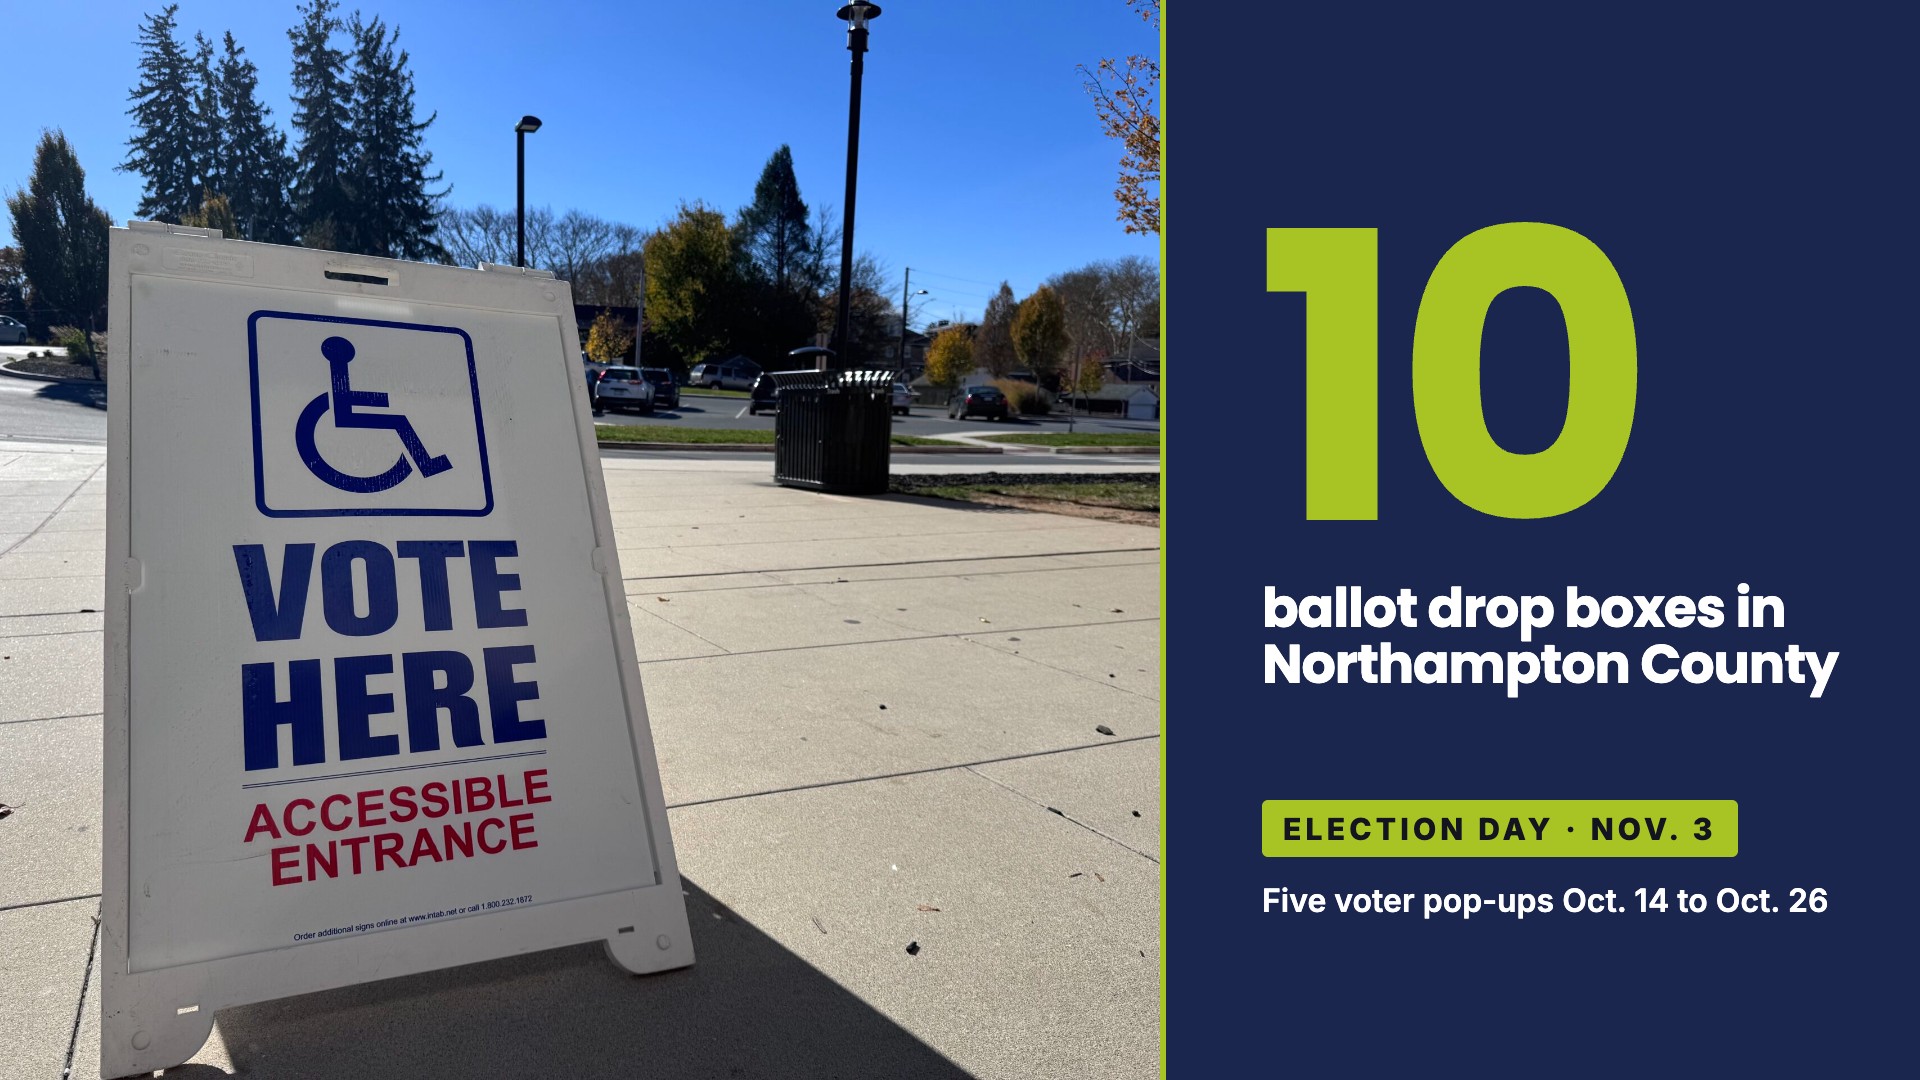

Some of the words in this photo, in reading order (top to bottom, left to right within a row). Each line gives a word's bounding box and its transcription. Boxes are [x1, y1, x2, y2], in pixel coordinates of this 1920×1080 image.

[232, 540, 528, 642] VOTE
[242, 644, 548, 772] HERE
[244, 768, 552, 843] ACCESSIBLE
[271, 812, 539, 886] ENTRANCE
[293, 931, 315, 941] Order
[317, 925, 354, 938] additional
[355, 922, 375, 932] signs
[376, 918, 398, 928] online
[399, 916, 407, 924] at
[408, 908, 458, 922] www.intab.net
[467, 903, 480, 913] call
[481, 895, 533, 909] 1.800.232.1872
